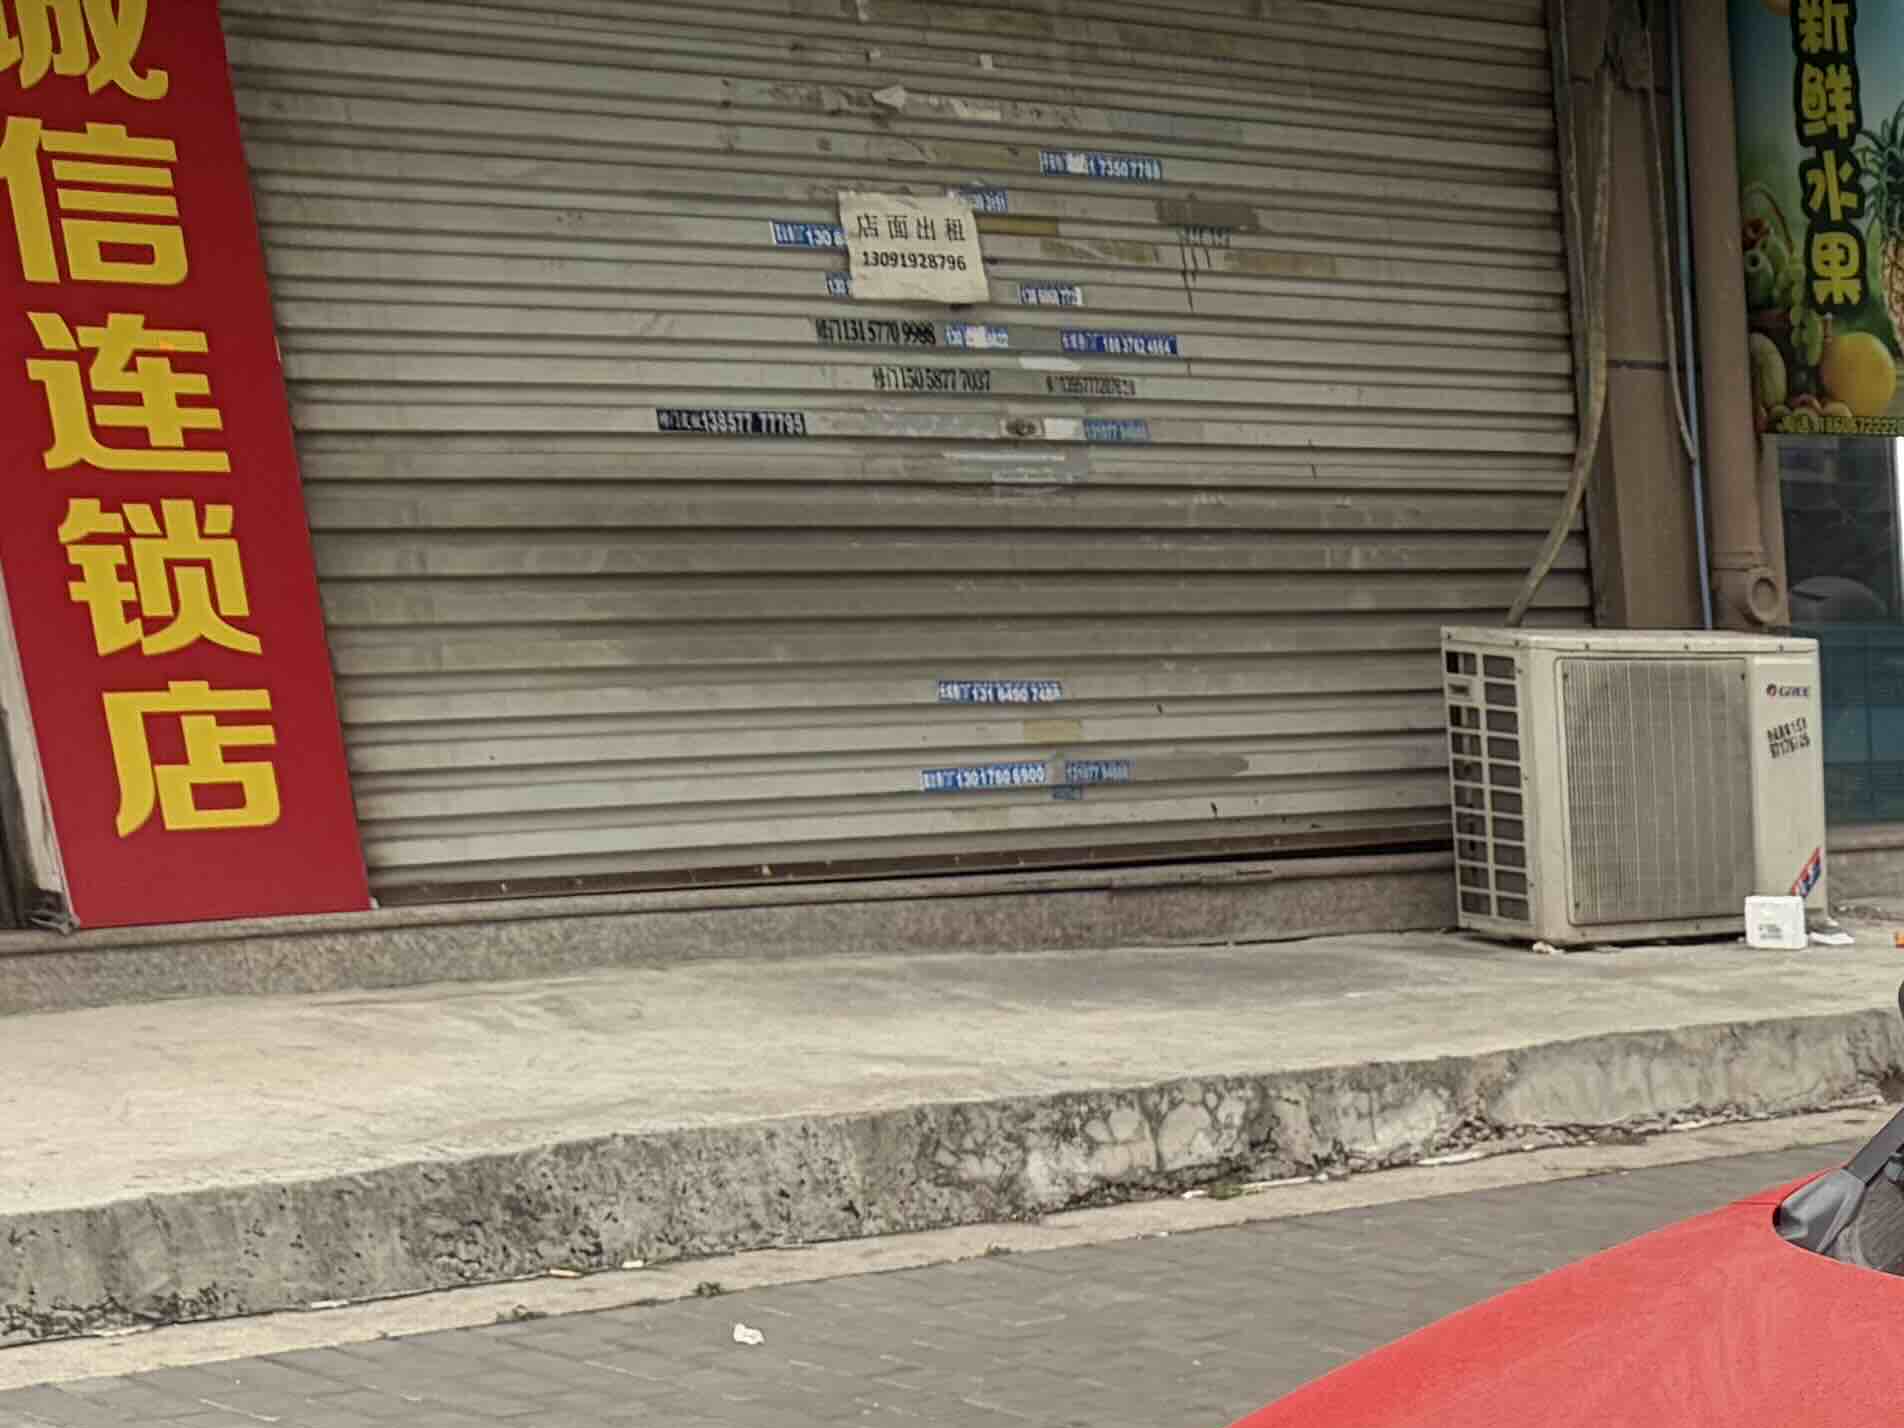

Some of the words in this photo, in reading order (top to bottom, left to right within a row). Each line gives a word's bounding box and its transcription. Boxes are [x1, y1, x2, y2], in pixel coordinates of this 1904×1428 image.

[1797, 0, 1862, 305] 新鲜水果
[857, 213, 966, 242] 店面出租
[862, 250, 967, 271] 13091928796
